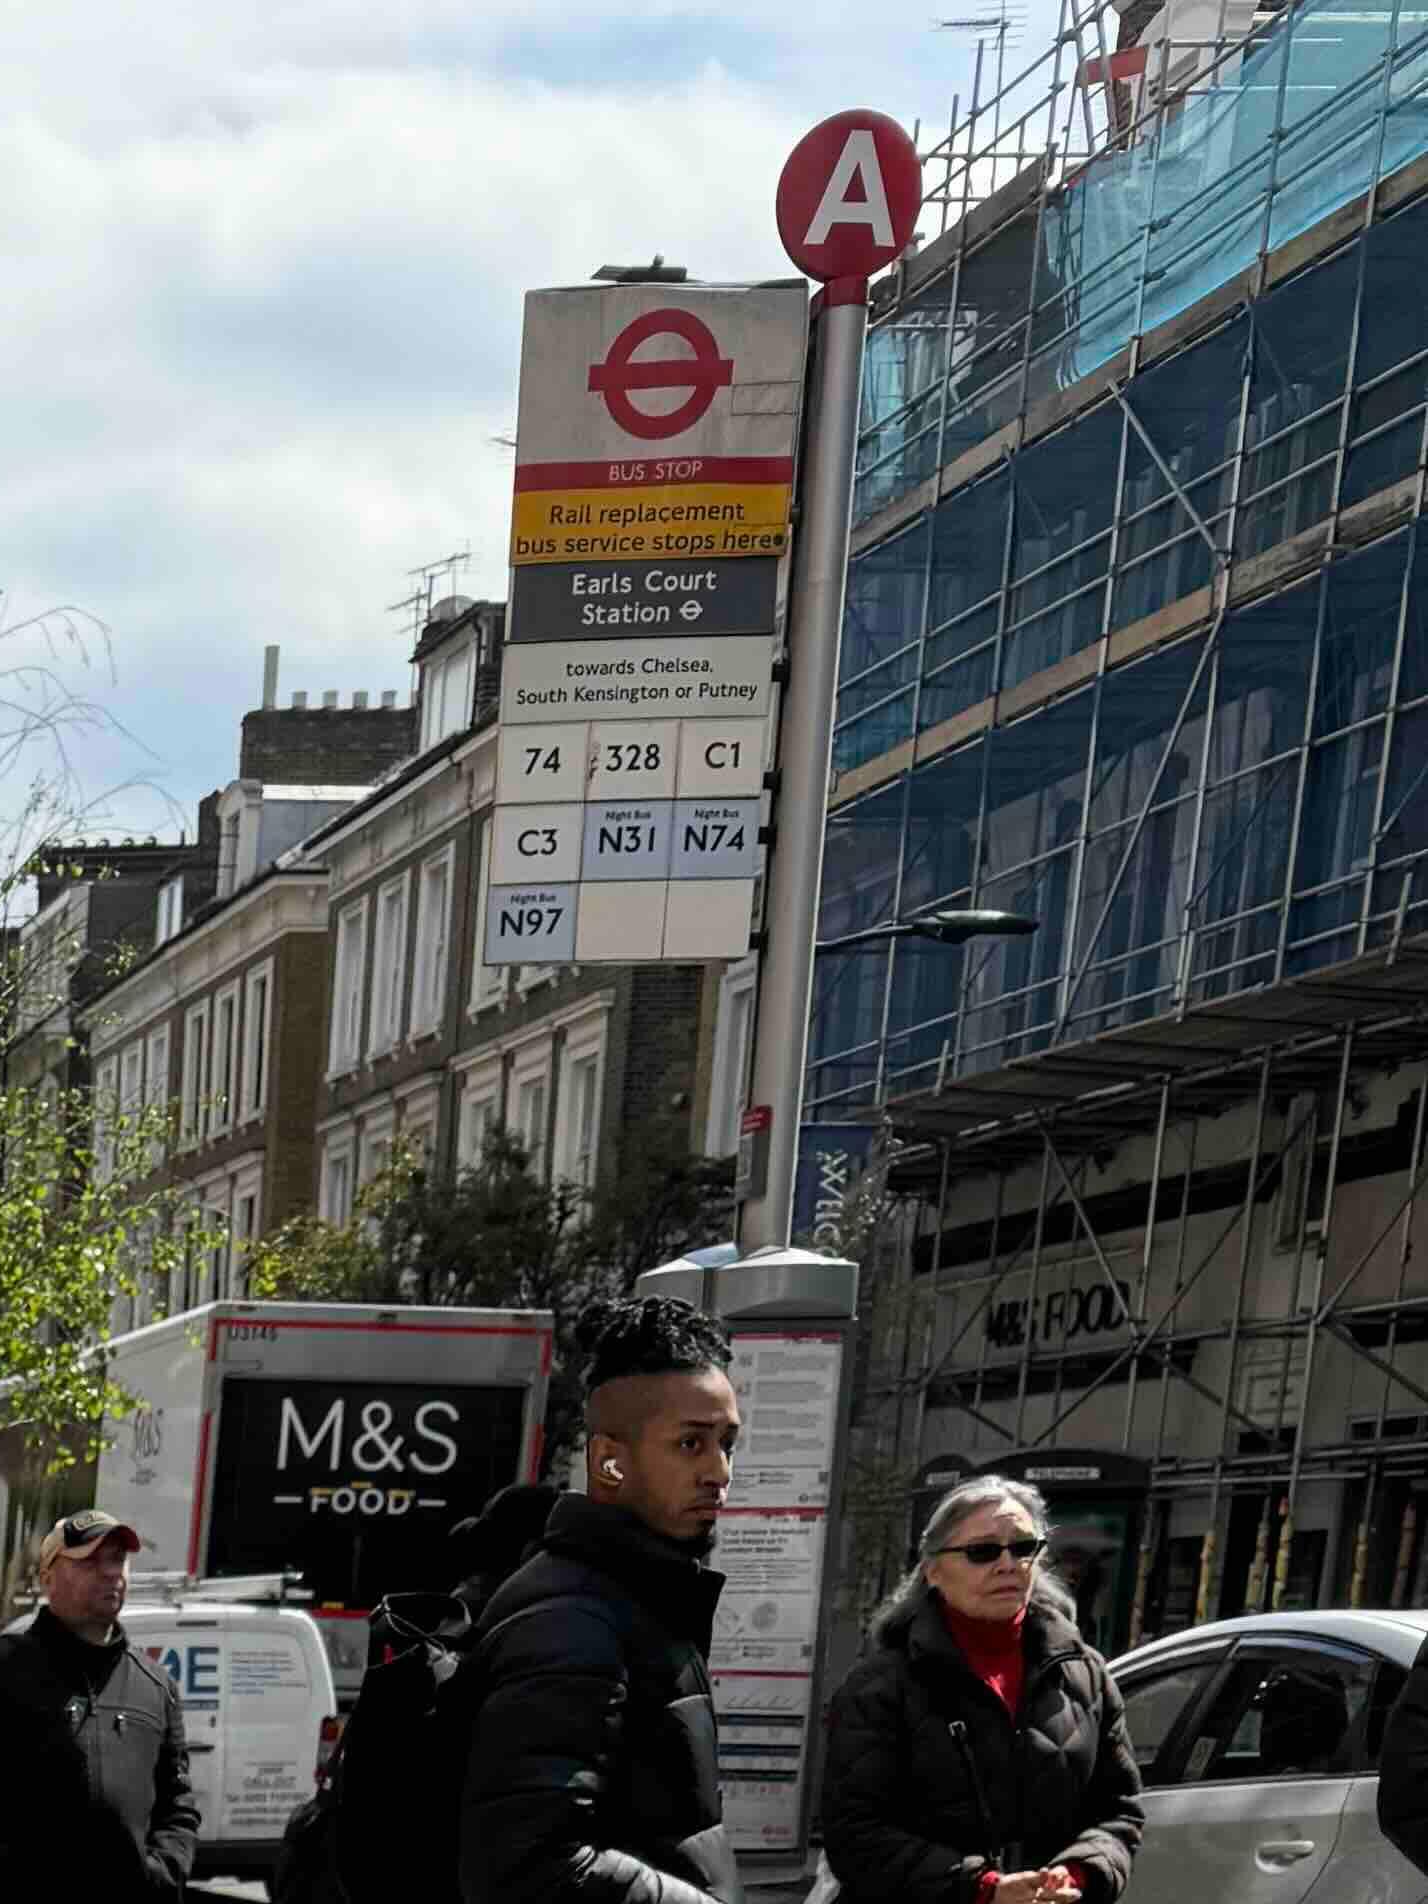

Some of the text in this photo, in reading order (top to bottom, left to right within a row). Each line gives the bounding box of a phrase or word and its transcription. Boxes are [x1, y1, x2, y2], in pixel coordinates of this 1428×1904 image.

[802, 129, 896, 247] A
[608, 460, 703, 482] BUS STOP
[548, 501, 745, 527] Rail replacement
[516, 527, 772, 555] bus service stops here
[571, 570, 718, 596] Earls Court
[581, 602, 671, 626] Station
[565, 660, 636, 677] towards
[516, 681, 758, 706] South Kensington or Putney
[523, 741, 742, 775] 74 328 C1
[517, 824, 746, 857] C3 N31 N74
[500, 908, 564, 937] N97
[1045, 1280, 1130, 1341] FOOD
[276, 1397, 460, 1475] M&S
[310, 1487, 415, 1515] FOOD
